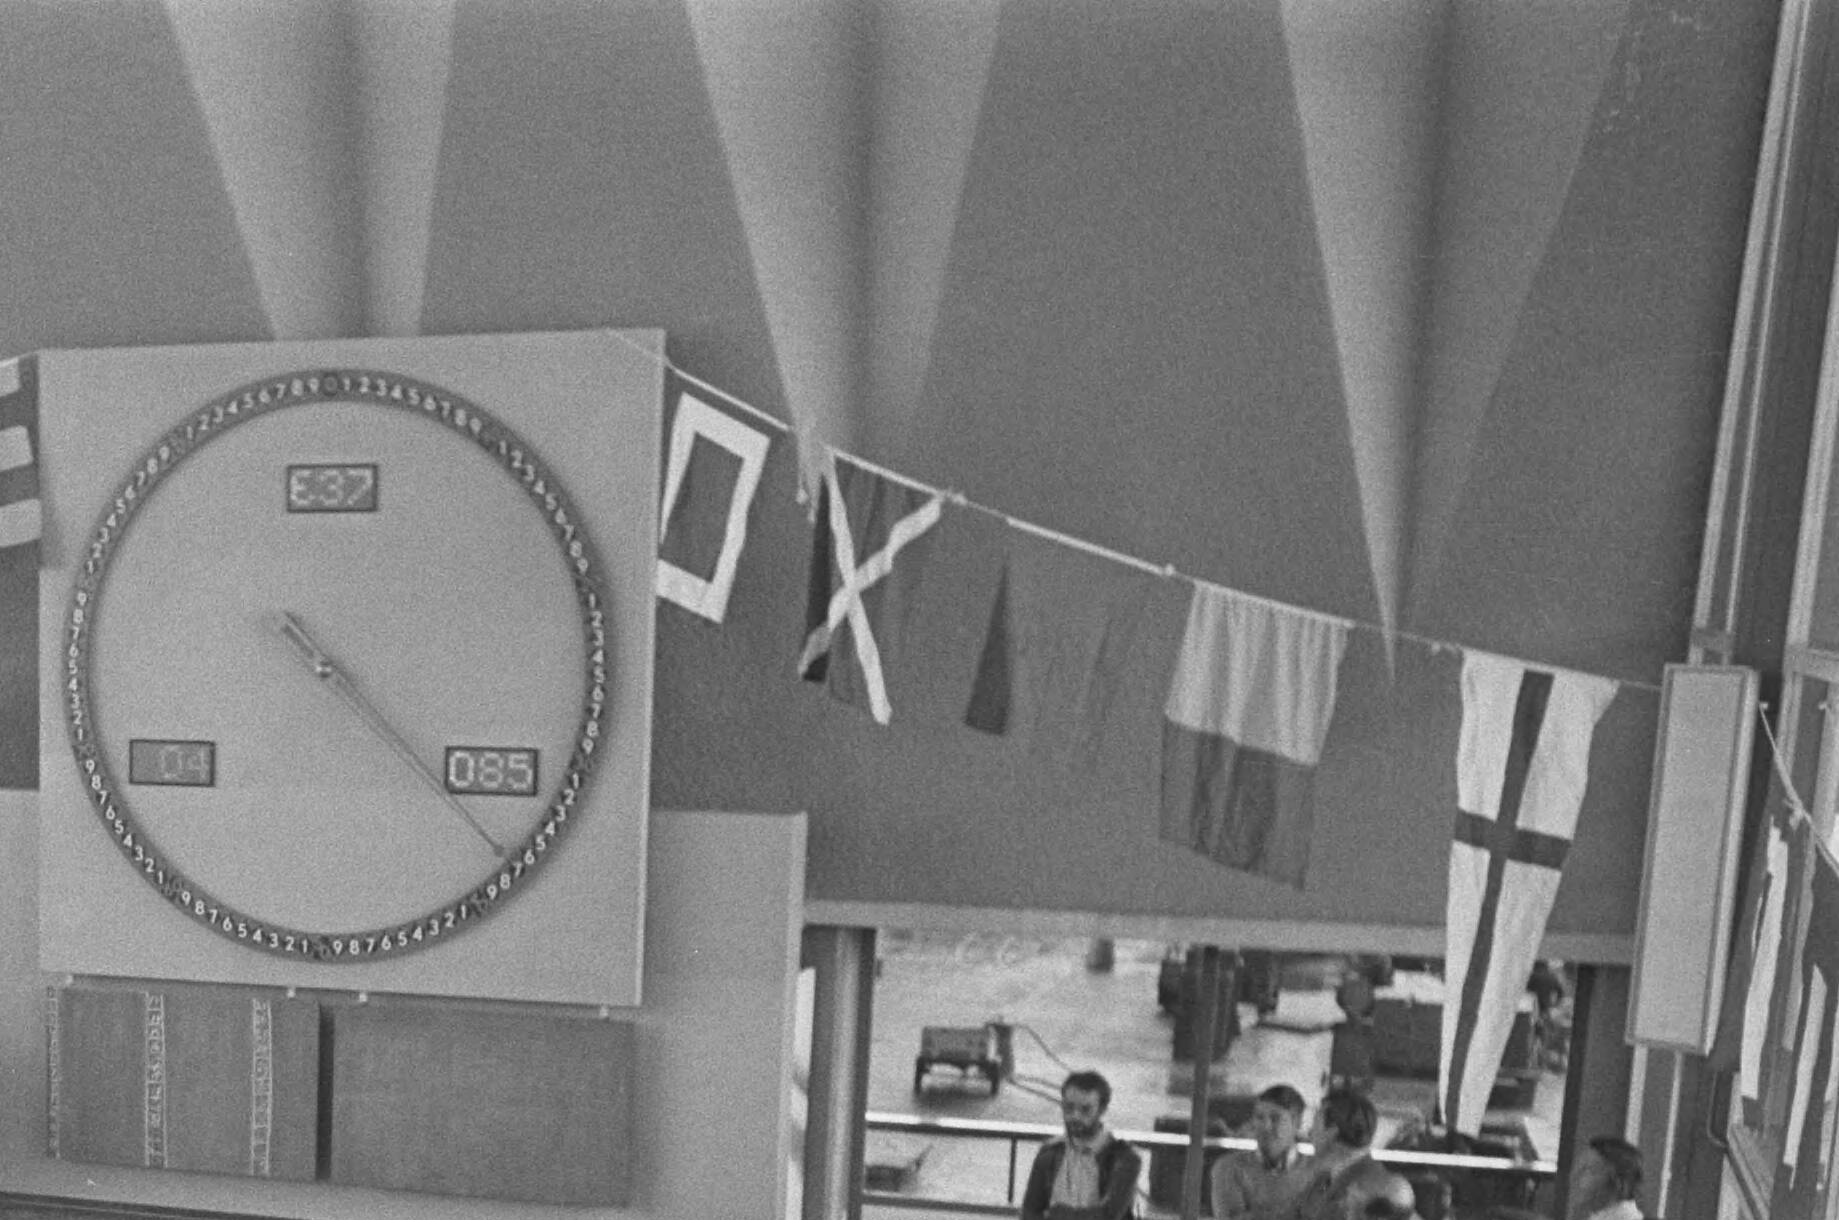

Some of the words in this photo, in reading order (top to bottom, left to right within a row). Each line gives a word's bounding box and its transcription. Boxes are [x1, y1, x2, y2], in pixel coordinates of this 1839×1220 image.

[200, 415, 208, 431] 2
[244, 393, 254, 408] 5
[360, 376, 369, 393] 2
[377, 379, 386, 396] 3
[391, 385, 402, 399] 4
[409, 388, 419, 405] 5
[424, 396, 436, 410] 6
[442, 402, 450, 417] 7
[455, 409, 466, 426] 8
[470, 418, 481, 434] 9
[512, 450, 522, 468] 2
[546, 493, 556, 510] 5
[92, 543, 101, 558] 2
[116, 498, 125, 514] 5
[77, 591, 87, 606] 9
[74, 608, 83, 624] 8
[590, 611, 603, 627] 2
[72, 626, 80, 640] 7
[593, 629, 604, 646] 3
[69, 643, 79, 658] 6
[592, 649, 604, 664] 4
[68, 659, 78, 674] 5
[594, 665, 605, 683] 5
[69, 677, 77, 691] 4
[592, 684, 604, 701] 6
[70, 693, 80, 708] 3
[73, 709, 83, 725] 2
[592, 702, 600, 719] 7
[587, 720, 598, 738] 8
[582, 738, 594, 754] 9
[449, 751, 533, 789] 085
[564, 787, 576, 806] 2
[85, 758, 95, 774] 9
[91, 774, 101, 789] 8
[98, 790, 108, 804] 7
[106, 803, 116, 820] 6
[114, 818, 124, 834] 5
[123, 832, 132, 847] 4
[135, 845, 144, 861] 3
[145, 857, 154, 873] 2
[556, 804, 566, 822] 3
[544, 820, 555, 836] 4
[536, 834, 546, 851] 5
[524, 848, 535, 865] 6
[513, 861, 523, 878] 7
[500, 872, 511, 890] 8
[487, 884, 498, 900] 9
[181, 890, 191, 905] 9
[195, 900, 205, 915] 8
[209, 908, 218, 923] 7
[223, 916, 232, 931] 6
[238, 922, 247, 938] 5
[252, 928, 262, 942] 4
[270, 932, 278, 948] 3
[286, 936, 294, 951] 2
[333, 940, 343, 954] 9
[350, 939, 360, 955] 8
[366, 937, 375, 953] 7
[381, 935, 391, 950] 6
[398, 930, 407, 946] 5
[412, 926, 422, 941] 4
[430, 919, 439, 936] 3
[444, 911, 455, 928] 2
